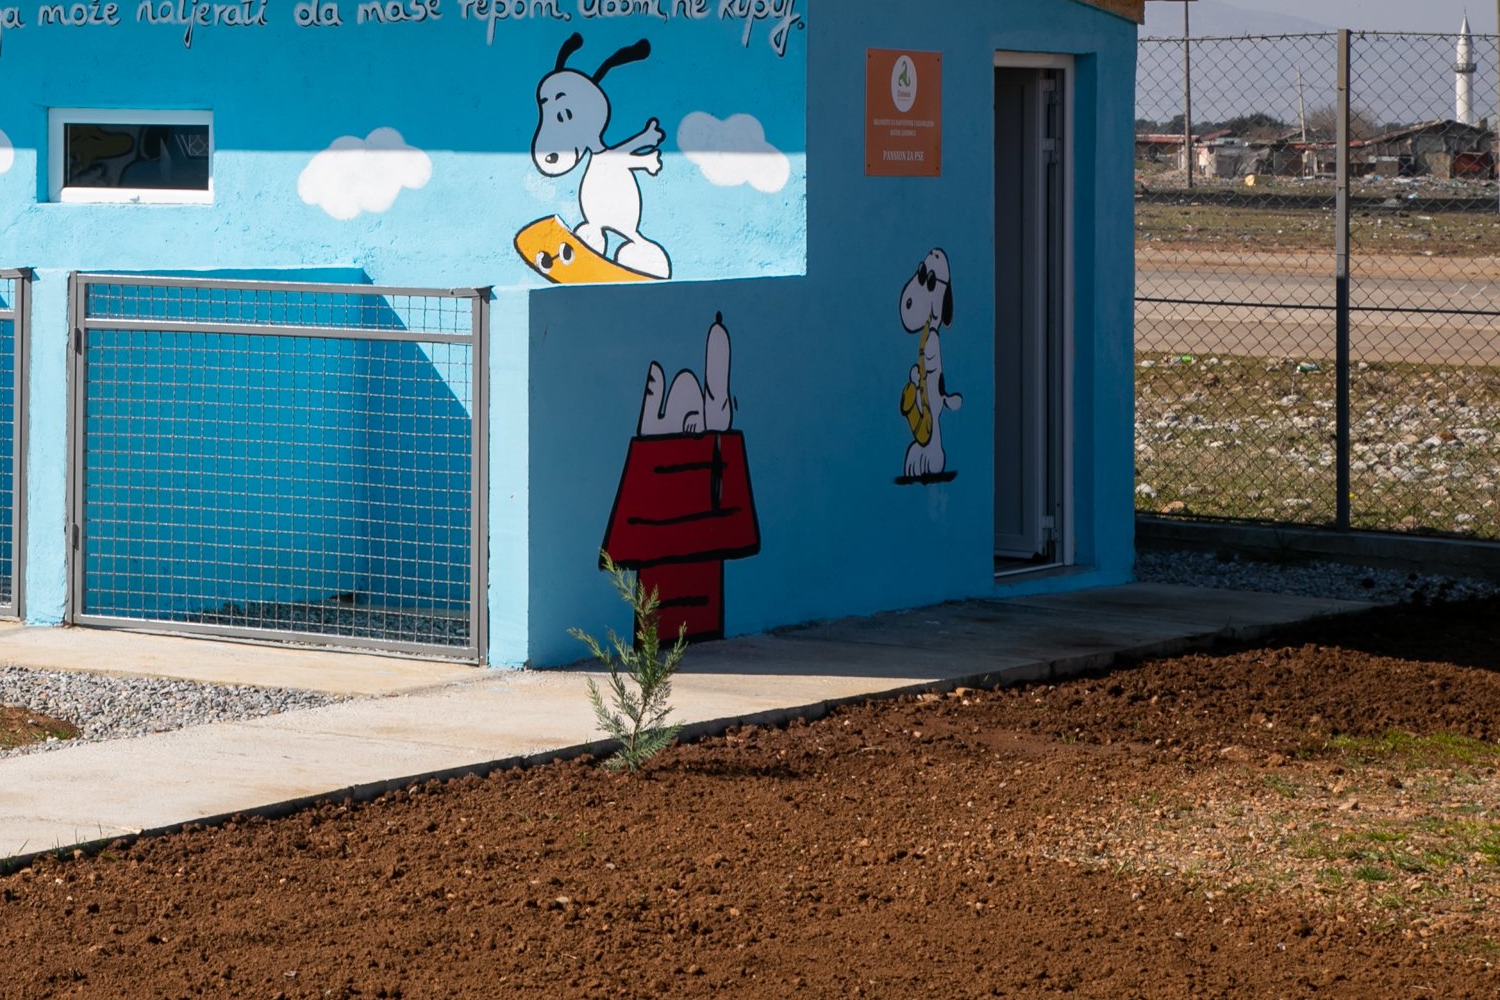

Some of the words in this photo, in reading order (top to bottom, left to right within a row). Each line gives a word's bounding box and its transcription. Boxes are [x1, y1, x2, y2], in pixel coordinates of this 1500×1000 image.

[883, 150, 906, 161] PANSION
[907, 150, 914, 161] ZA
[914, 151, 924, 161] PSE
